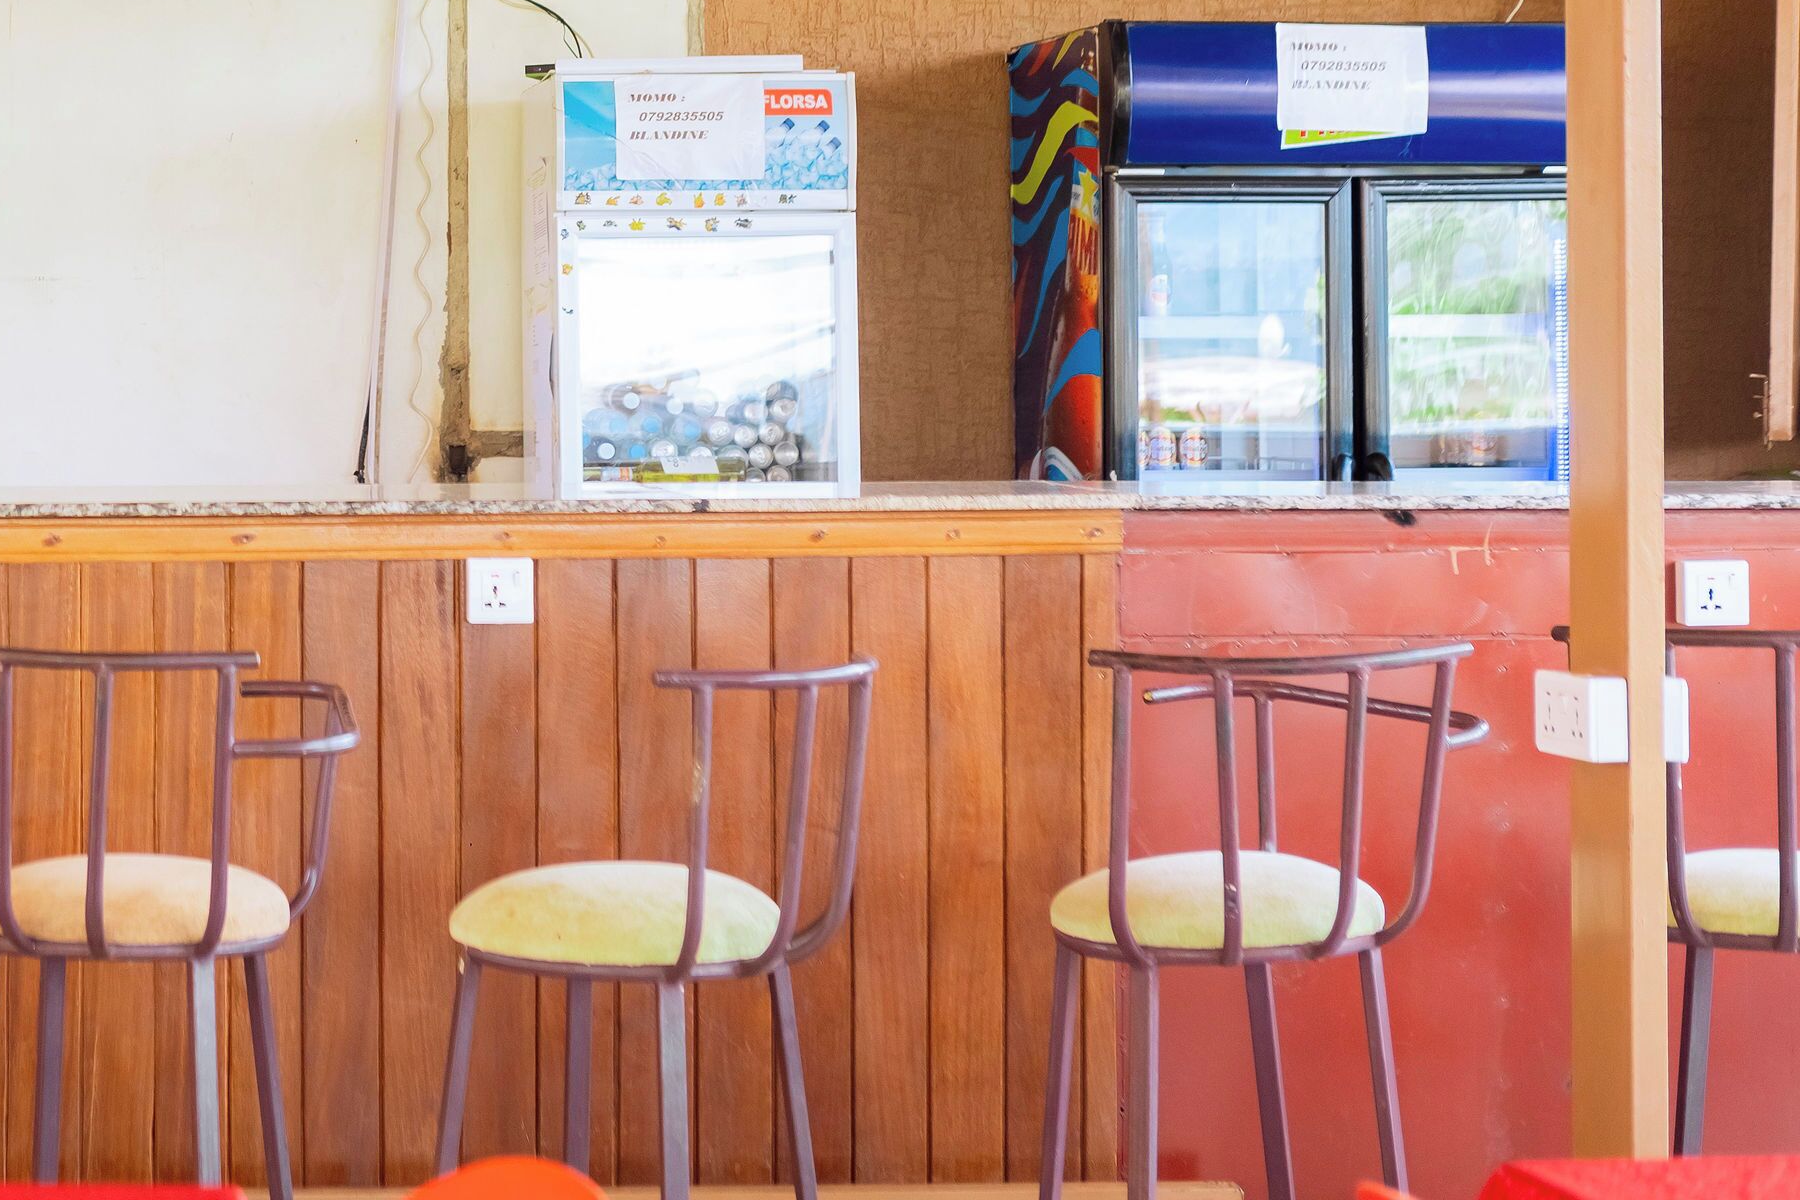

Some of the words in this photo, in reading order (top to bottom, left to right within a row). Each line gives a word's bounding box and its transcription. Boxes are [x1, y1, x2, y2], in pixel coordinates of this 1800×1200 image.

[1301, 60, 1387, 72] 0792835505
[628, 93, 677, 102] MOMO
[638, 111, 724, 122] 0792835505
[629, 130, 709, 140] BLANDINE
